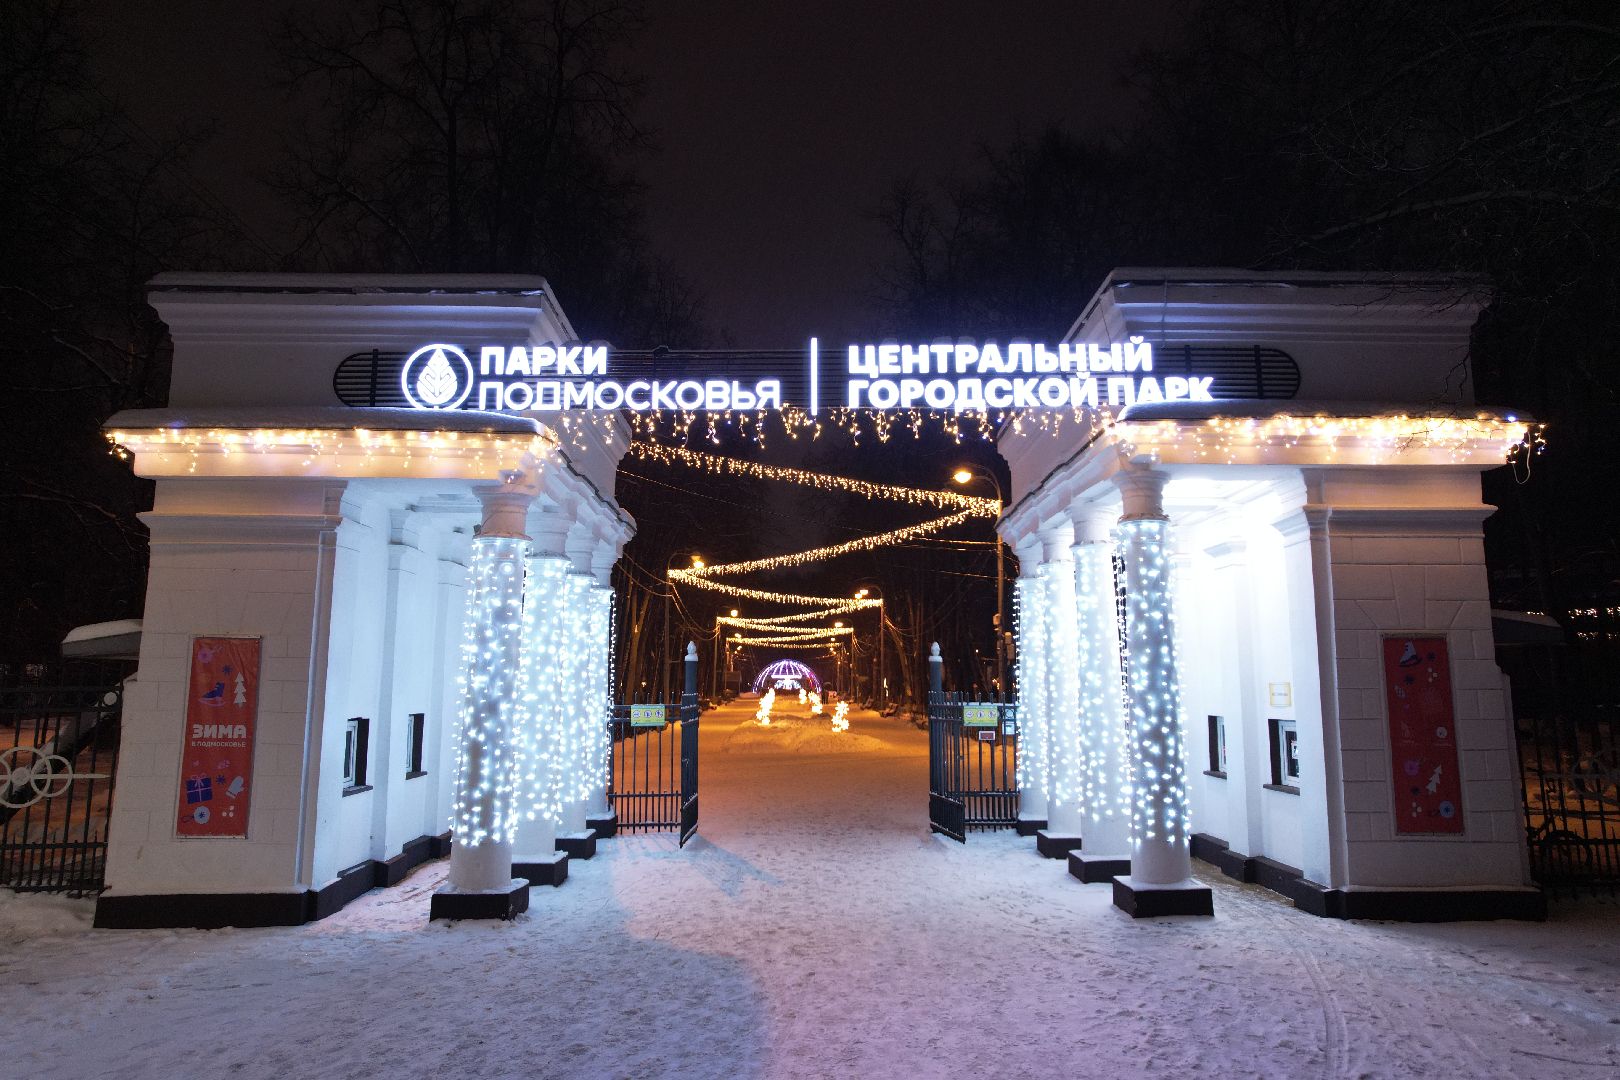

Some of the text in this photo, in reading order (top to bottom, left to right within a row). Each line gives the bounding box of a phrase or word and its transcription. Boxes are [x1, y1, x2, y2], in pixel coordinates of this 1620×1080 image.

[480, 346, 607, 375] ПАРКИ
[847, 336, 1154, 378] ЦЕНТРАЛЬНЫЙ
[479, 380, 780, 410] ПОДМОСКОВЬЯ
[847, 372, 1214, 411] ГОРОДСКОЙ ПАРК
[191, 724, 247, 739] ЗИМА
